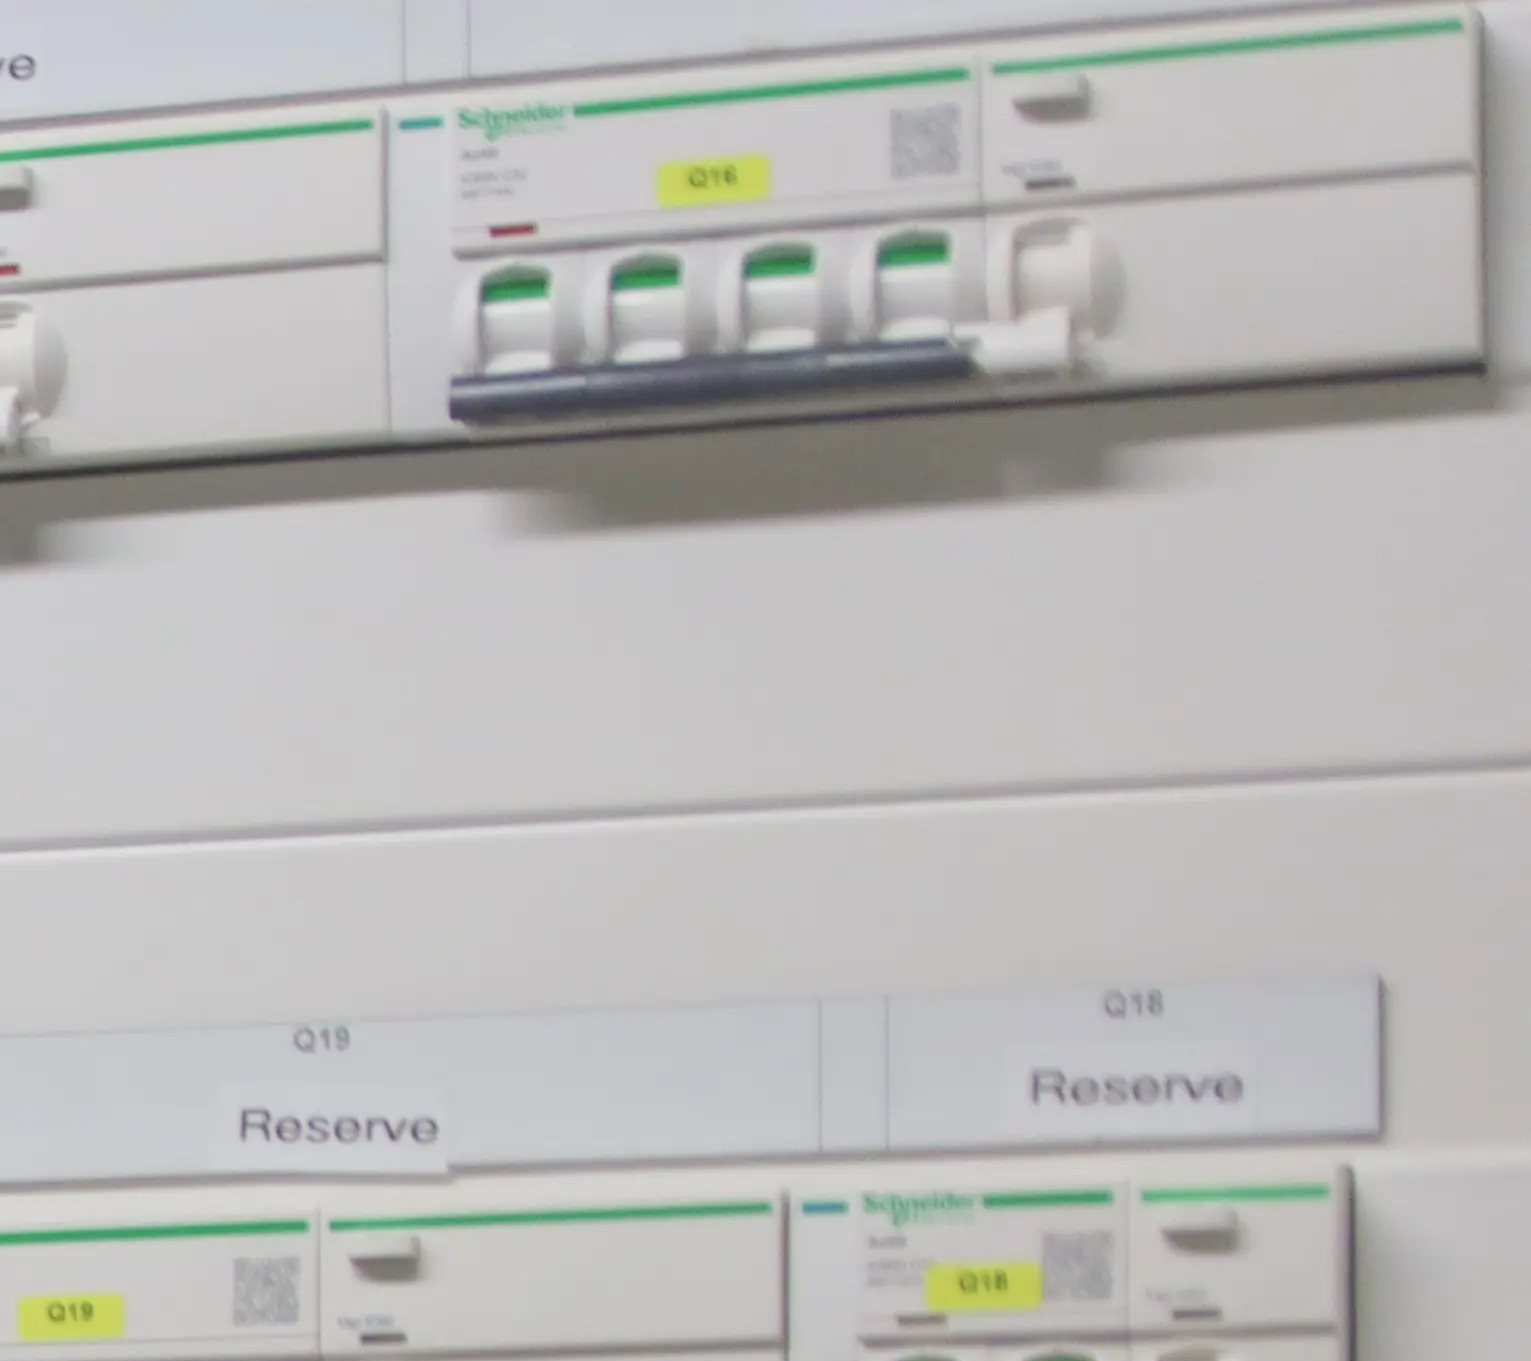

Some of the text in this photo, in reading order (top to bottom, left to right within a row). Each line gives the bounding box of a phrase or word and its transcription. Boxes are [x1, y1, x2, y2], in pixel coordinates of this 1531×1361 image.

[683, 159, 741, 188] Q16
[1100, 987, 1168, 1022] Q18
[289, 1026, 354, 1057] Q19
[1025, 1071, 1243, 1110] Reserve
[240, 1109, 439, 1143] Reserve
[954, 1268, 1011, 1298] Q18
[43, 1300, 99, 1325] Q19
